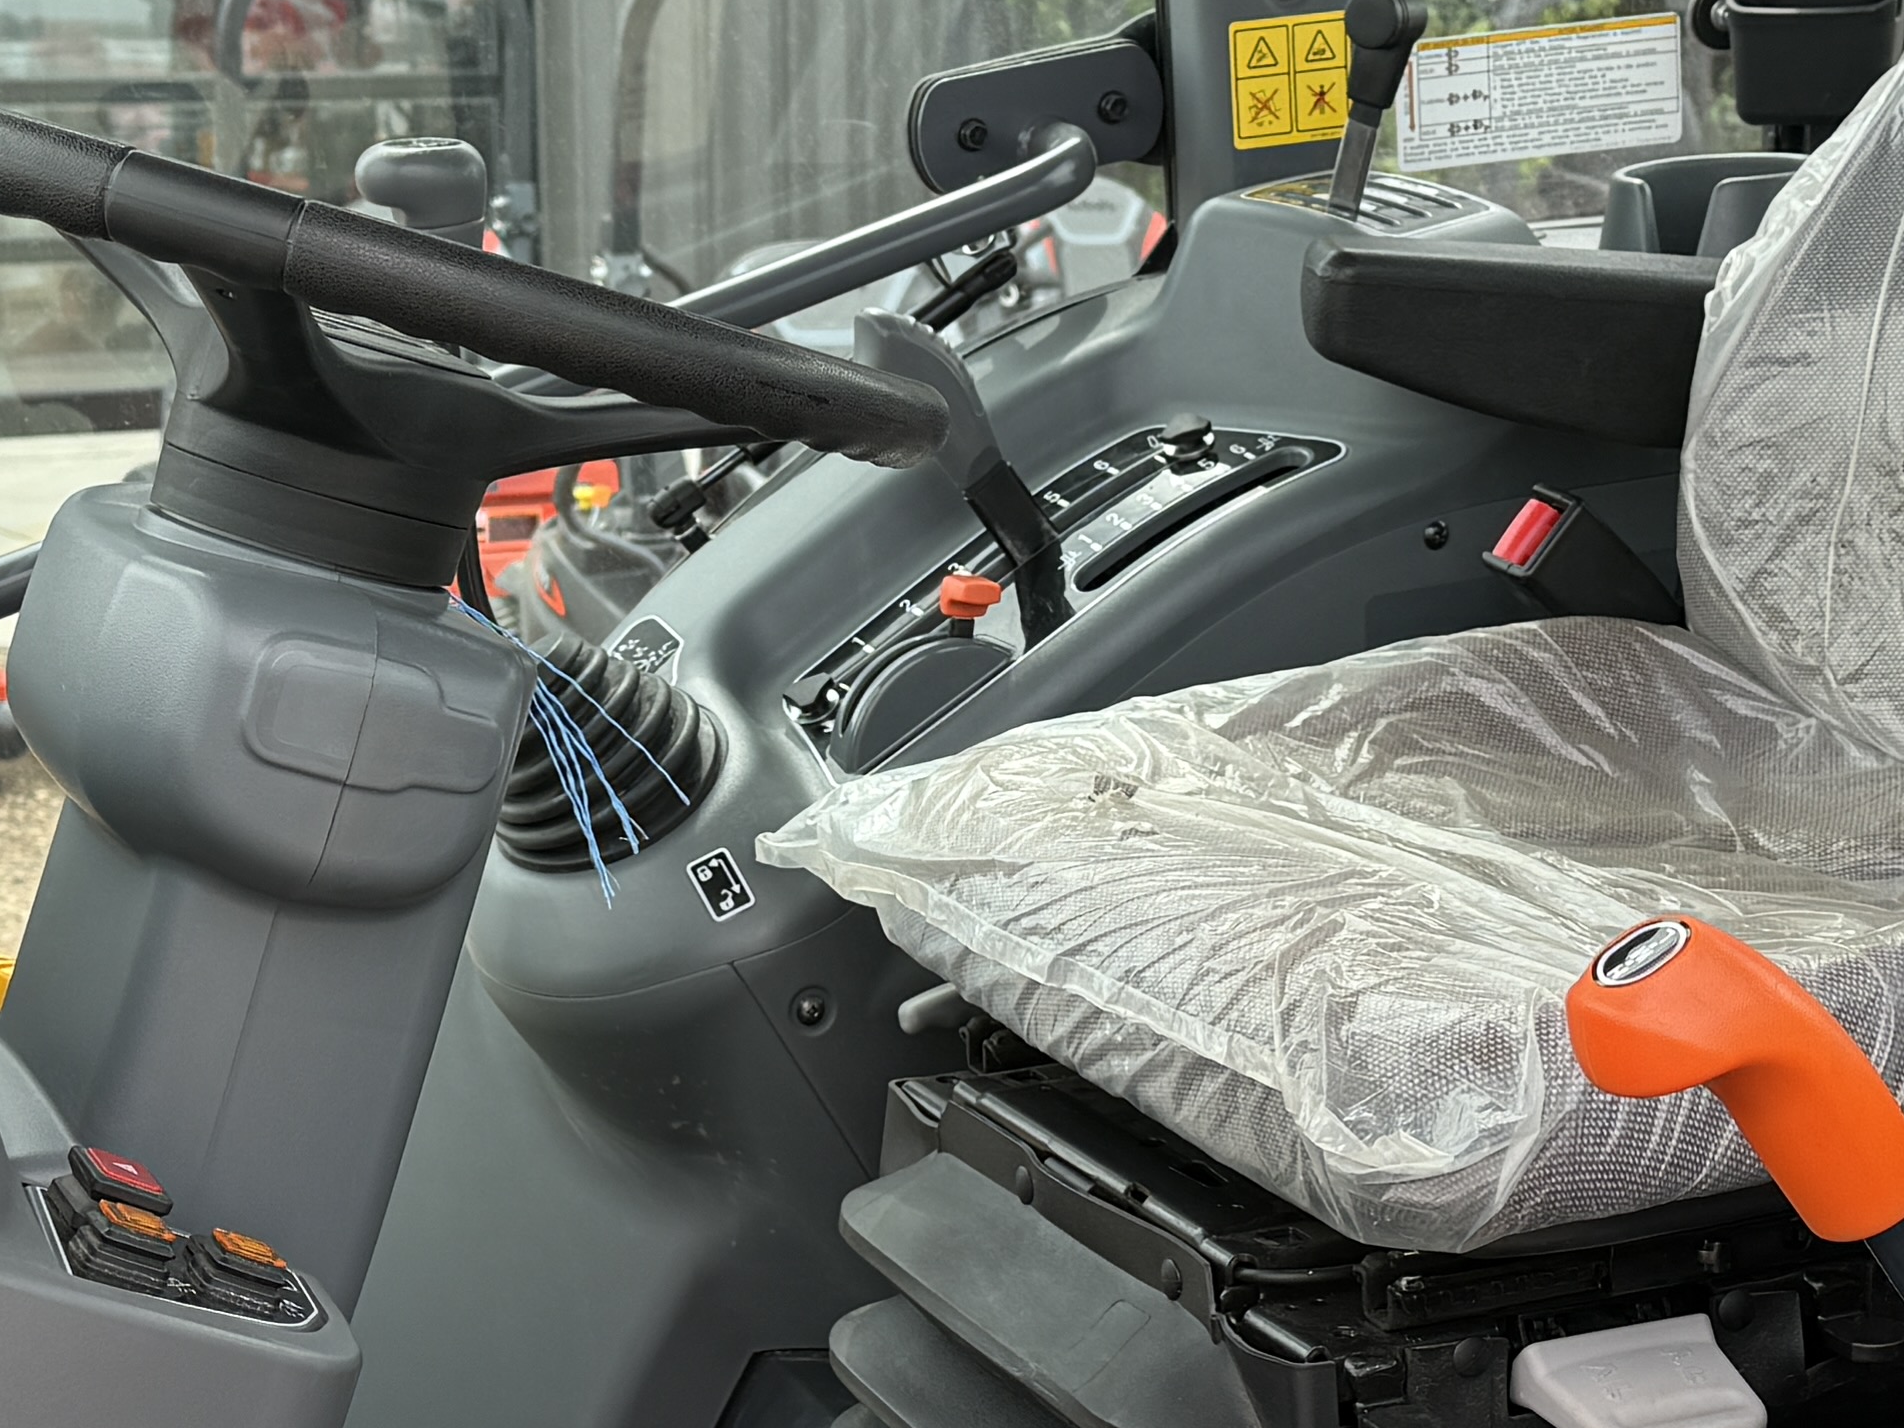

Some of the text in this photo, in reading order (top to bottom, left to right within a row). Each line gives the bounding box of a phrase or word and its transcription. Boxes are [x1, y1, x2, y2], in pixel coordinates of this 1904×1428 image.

[1093, 460, 1109, 471] 6
[1197, 458, 1215, 470] 5
[1043, 490, 1061, 504] 5
[1136, 493, 1154, 506] 3
[1106, 513, 1124, 527] 2
[1077, 534, 1092, 544] 1
[899, 599, 917, 613] 2
[851, 636, 866, 646] 1
